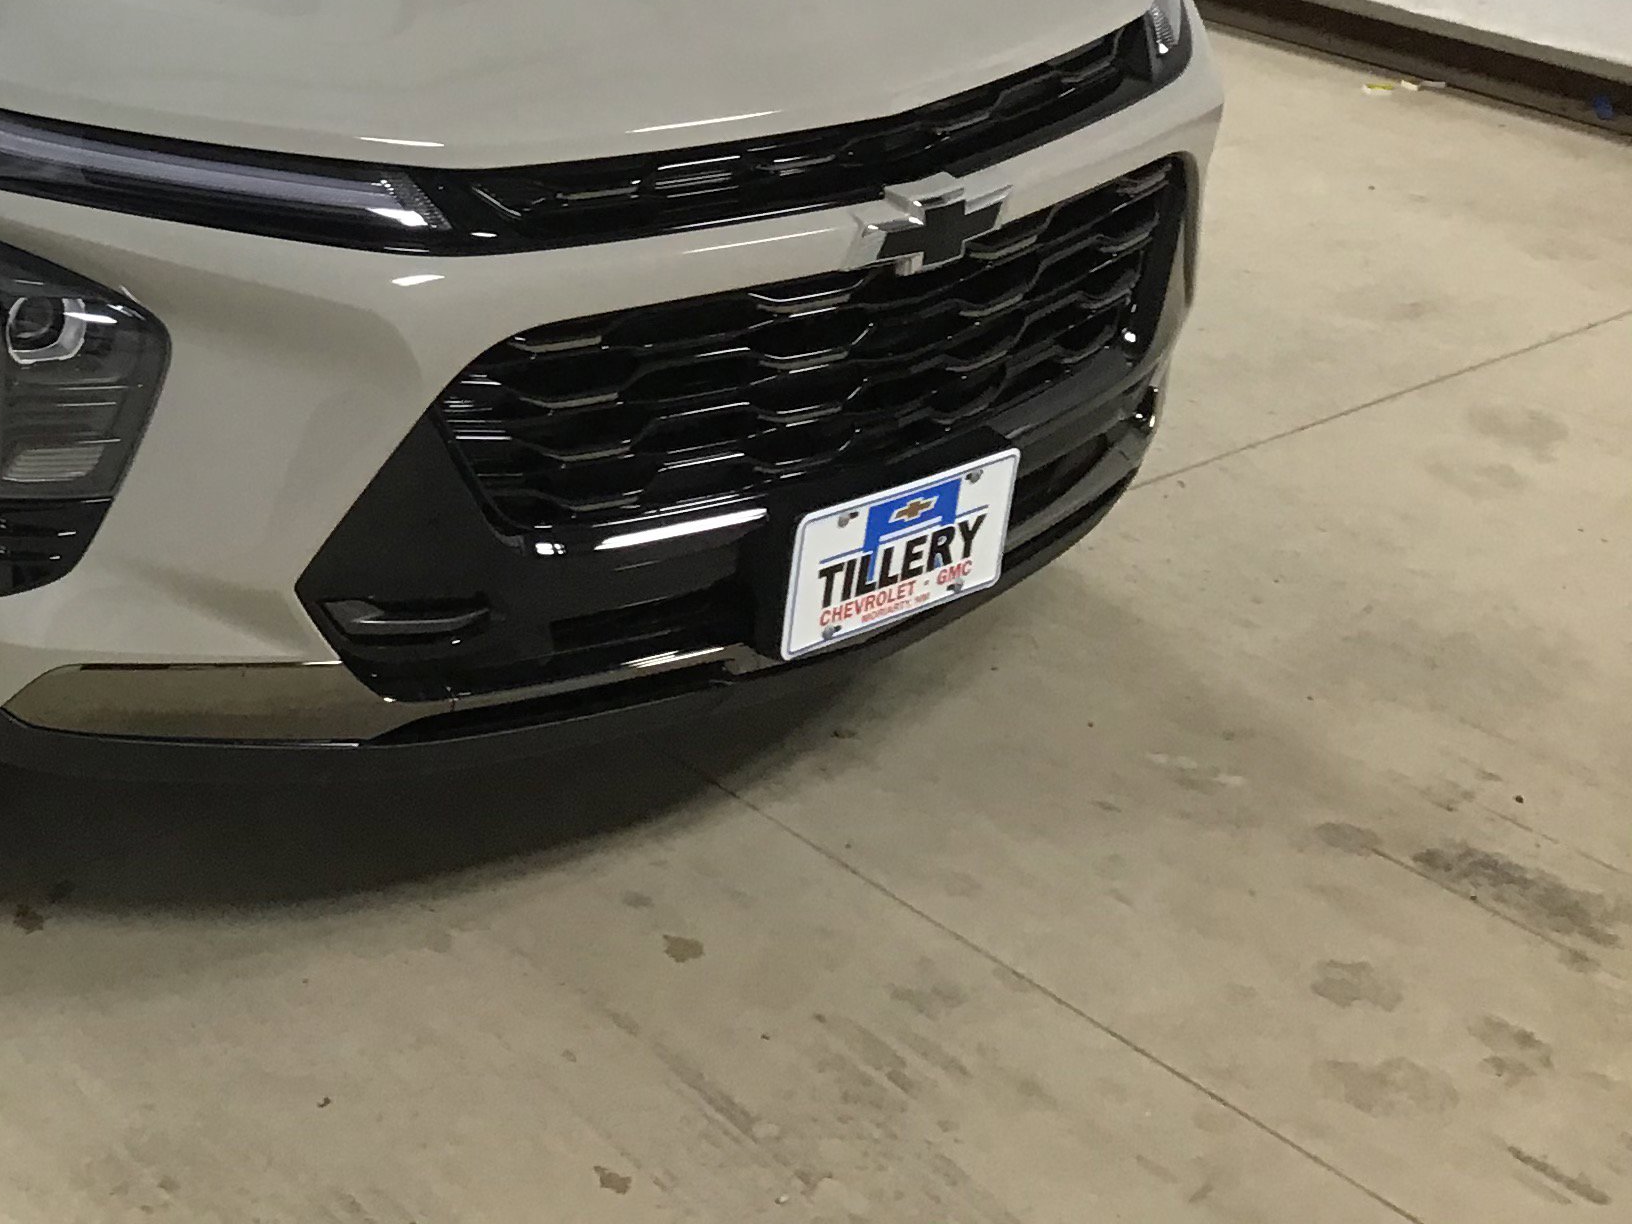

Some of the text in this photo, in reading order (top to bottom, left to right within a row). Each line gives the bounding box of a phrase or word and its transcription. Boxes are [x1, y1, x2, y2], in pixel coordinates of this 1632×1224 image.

[819, 513, 987, 609] TILLERY
[819, 560, 973, 626] CHEVROLET GMC
